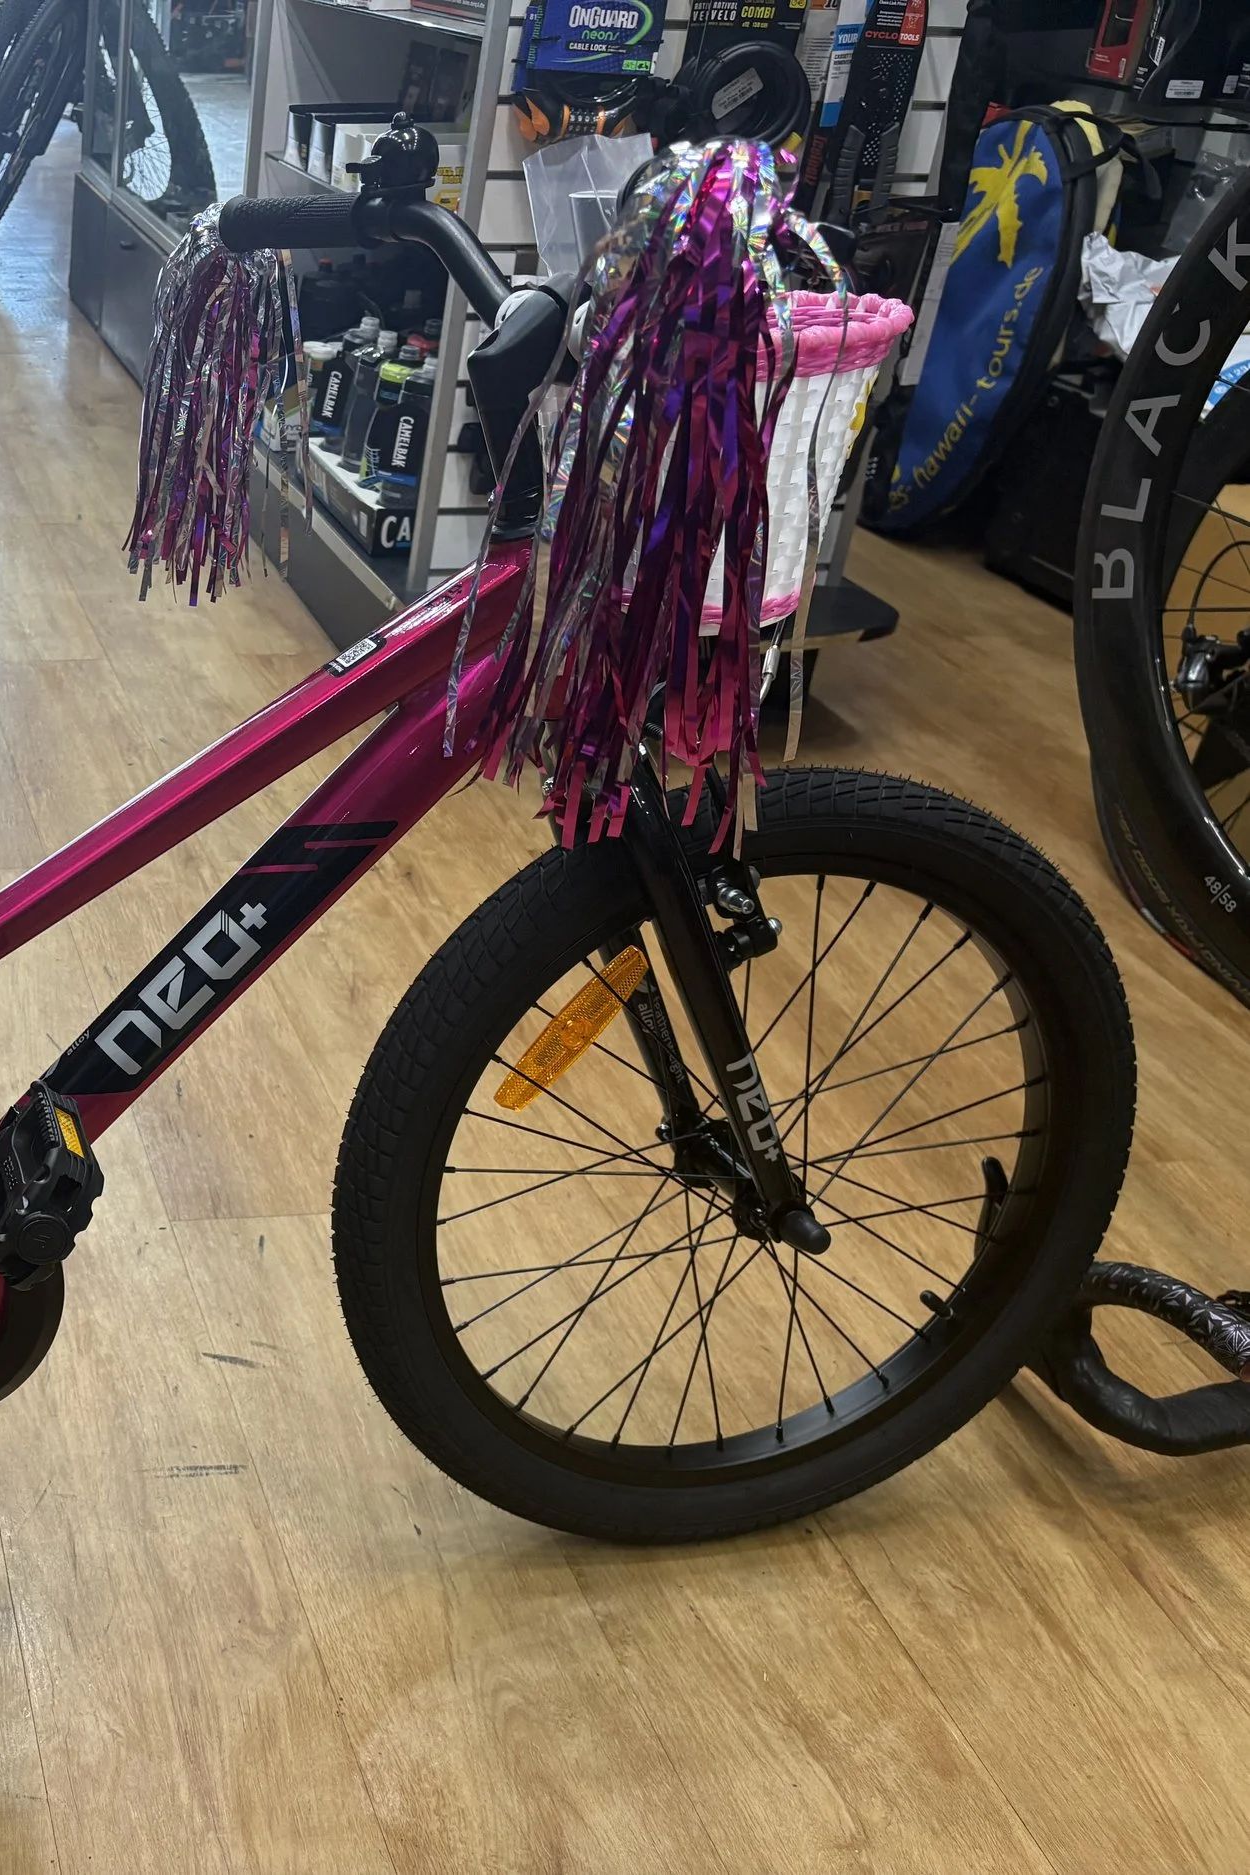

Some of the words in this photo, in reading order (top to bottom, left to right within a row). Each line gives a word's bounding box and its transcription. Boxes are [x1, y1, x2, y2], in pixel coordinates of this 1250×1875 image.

[710, 9, 737, 21] VELO
[741, 6, 776, 19] COMBI
[581, 30, 620, 41] neons
[838, 33, 859, 44] YOUR
[865, 30, 899, 40] CYCLO
[900, 33, 920, 41] TOOLS
[569, 42, 590, 51] CABLE
[590, 44, 607, 52] LOCK
[322, 370, 343, 418] CAMELBAK
[391, 415, 415, 468] CAMELBAK
[66, 1028, 91, 1056] alloy
